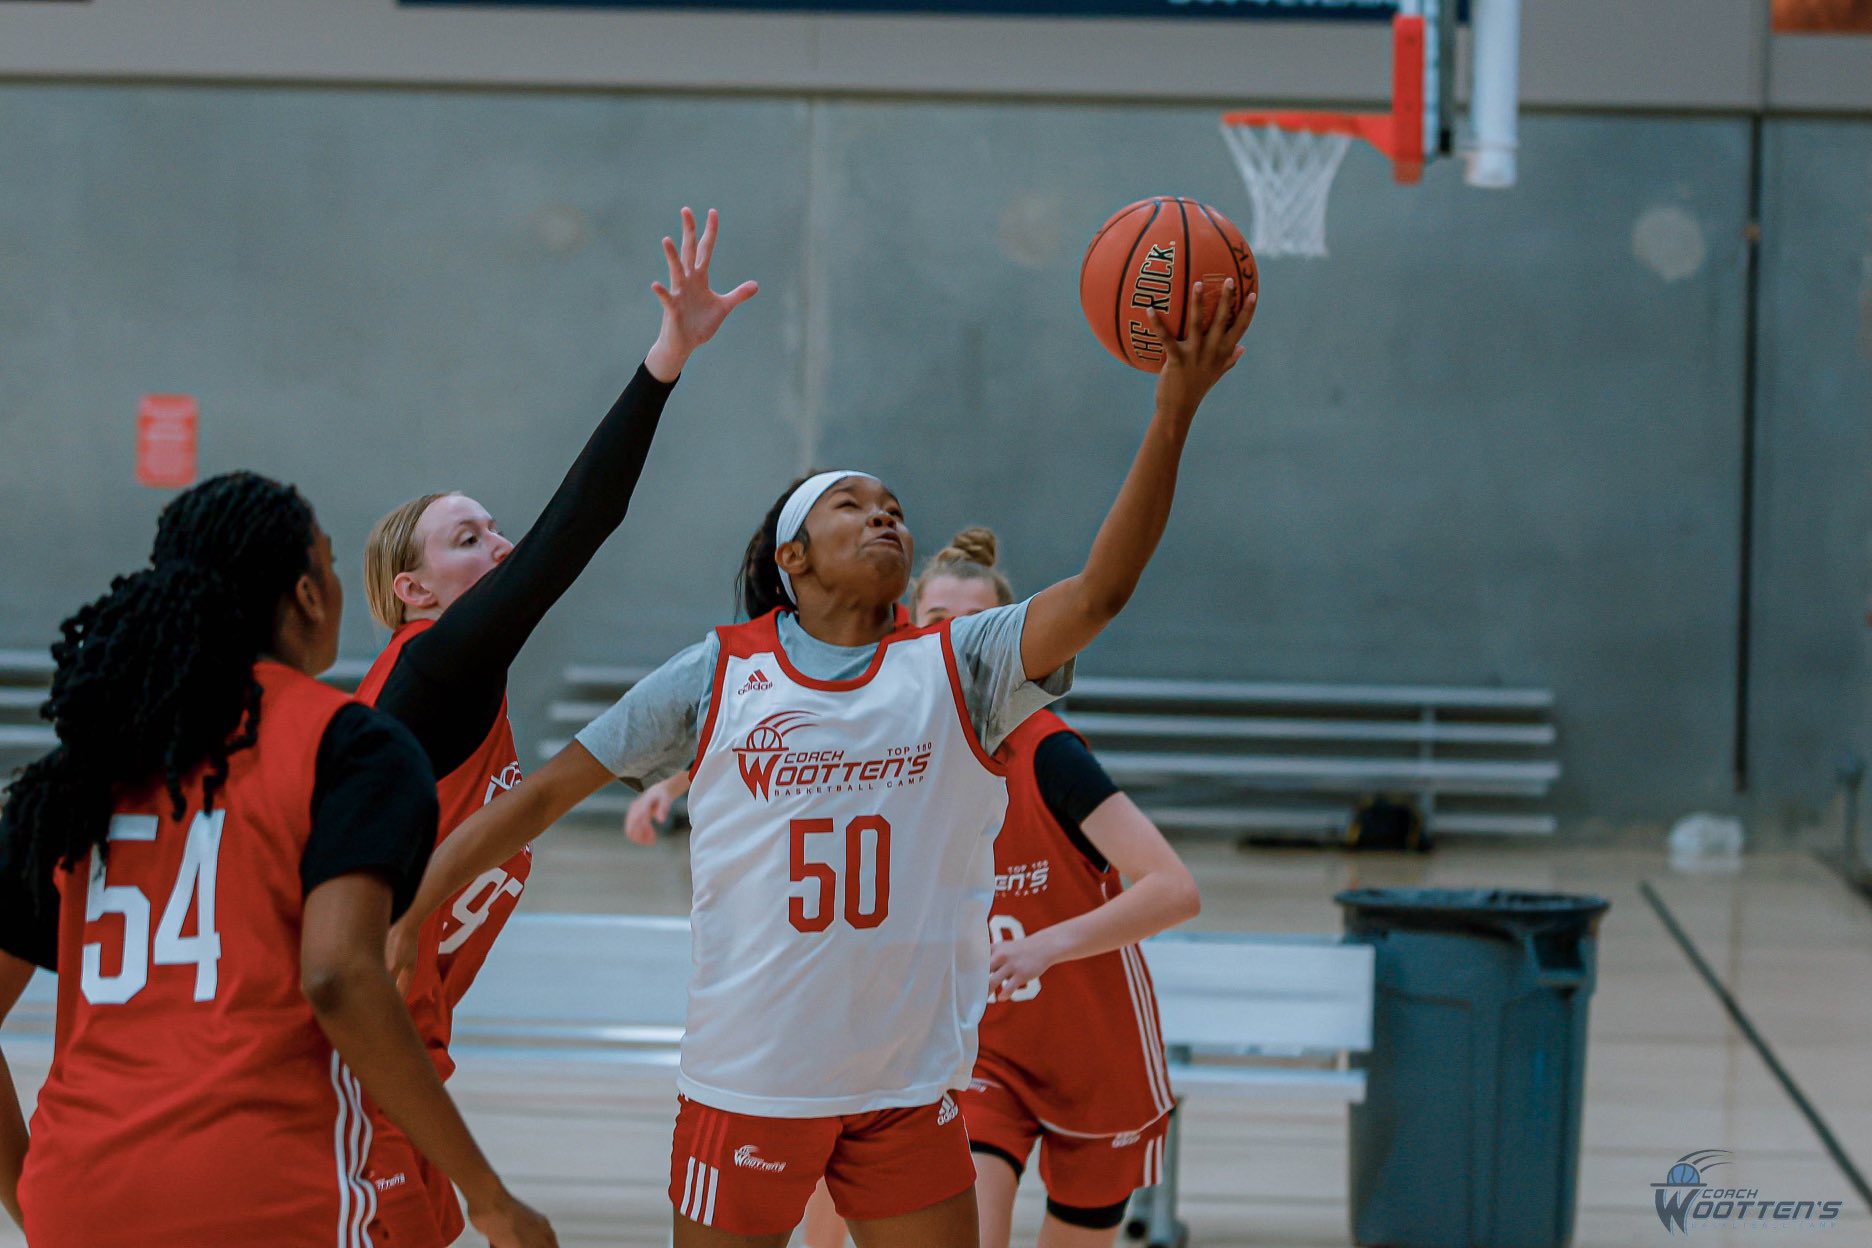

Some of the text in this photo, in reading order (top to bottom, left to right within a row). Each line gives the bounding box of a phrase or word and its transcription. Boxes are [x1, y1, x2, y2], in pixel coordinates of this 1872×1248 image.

[784, 750, 844, 764] COACH
[887, 747, 910, 756] TOP
[775, 775, 924, 797] BASKETBALL CAMP
[788, 814, 891, 933] 50
[81, 808, 226, 1005] 54
